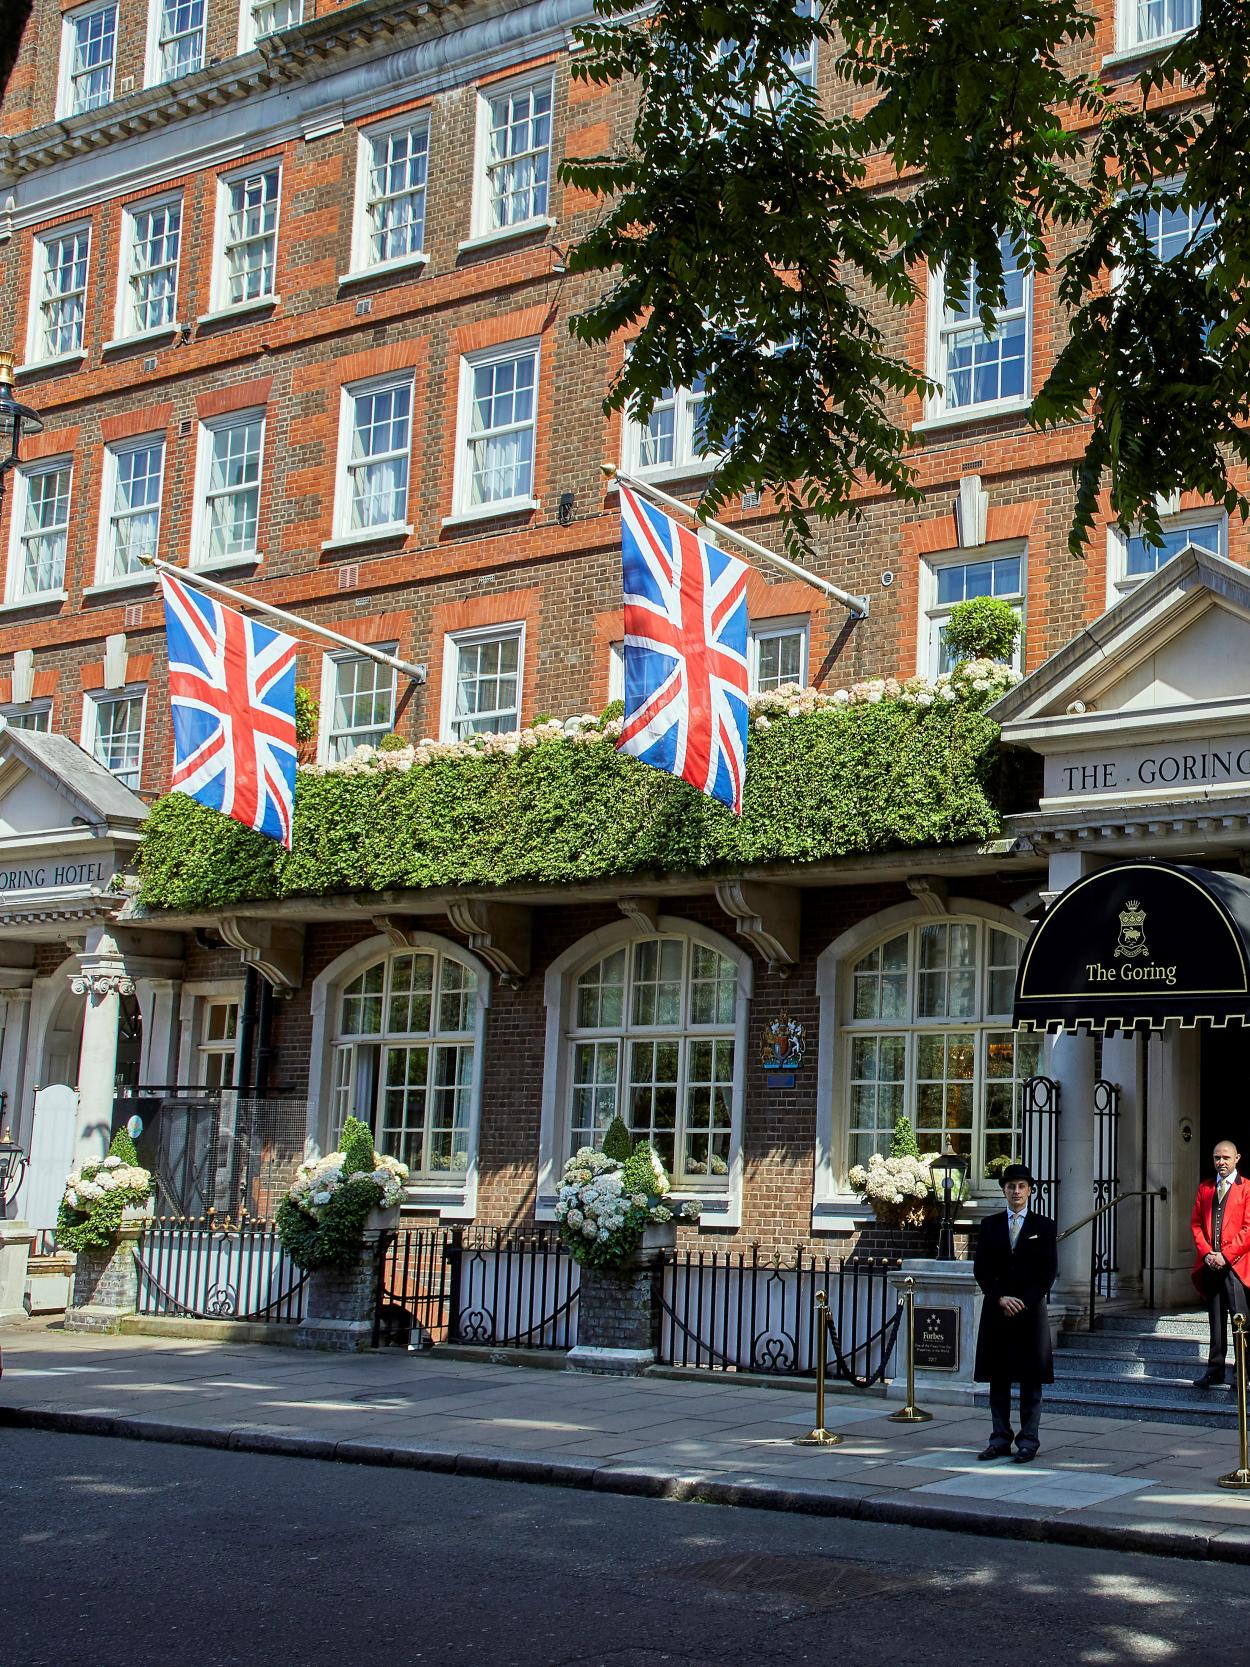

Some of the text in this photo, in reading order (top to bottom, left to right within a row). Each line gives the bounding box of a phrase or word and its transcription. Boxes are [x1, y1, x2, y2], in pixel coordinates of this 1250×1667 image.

[1063, 763, 1117, 791] THE
[0, 862, 105, 890] ORING HOTEL
[1085, 961, 1177, 986] The Goring
[923, 1331, 944, 1340] Forbes
